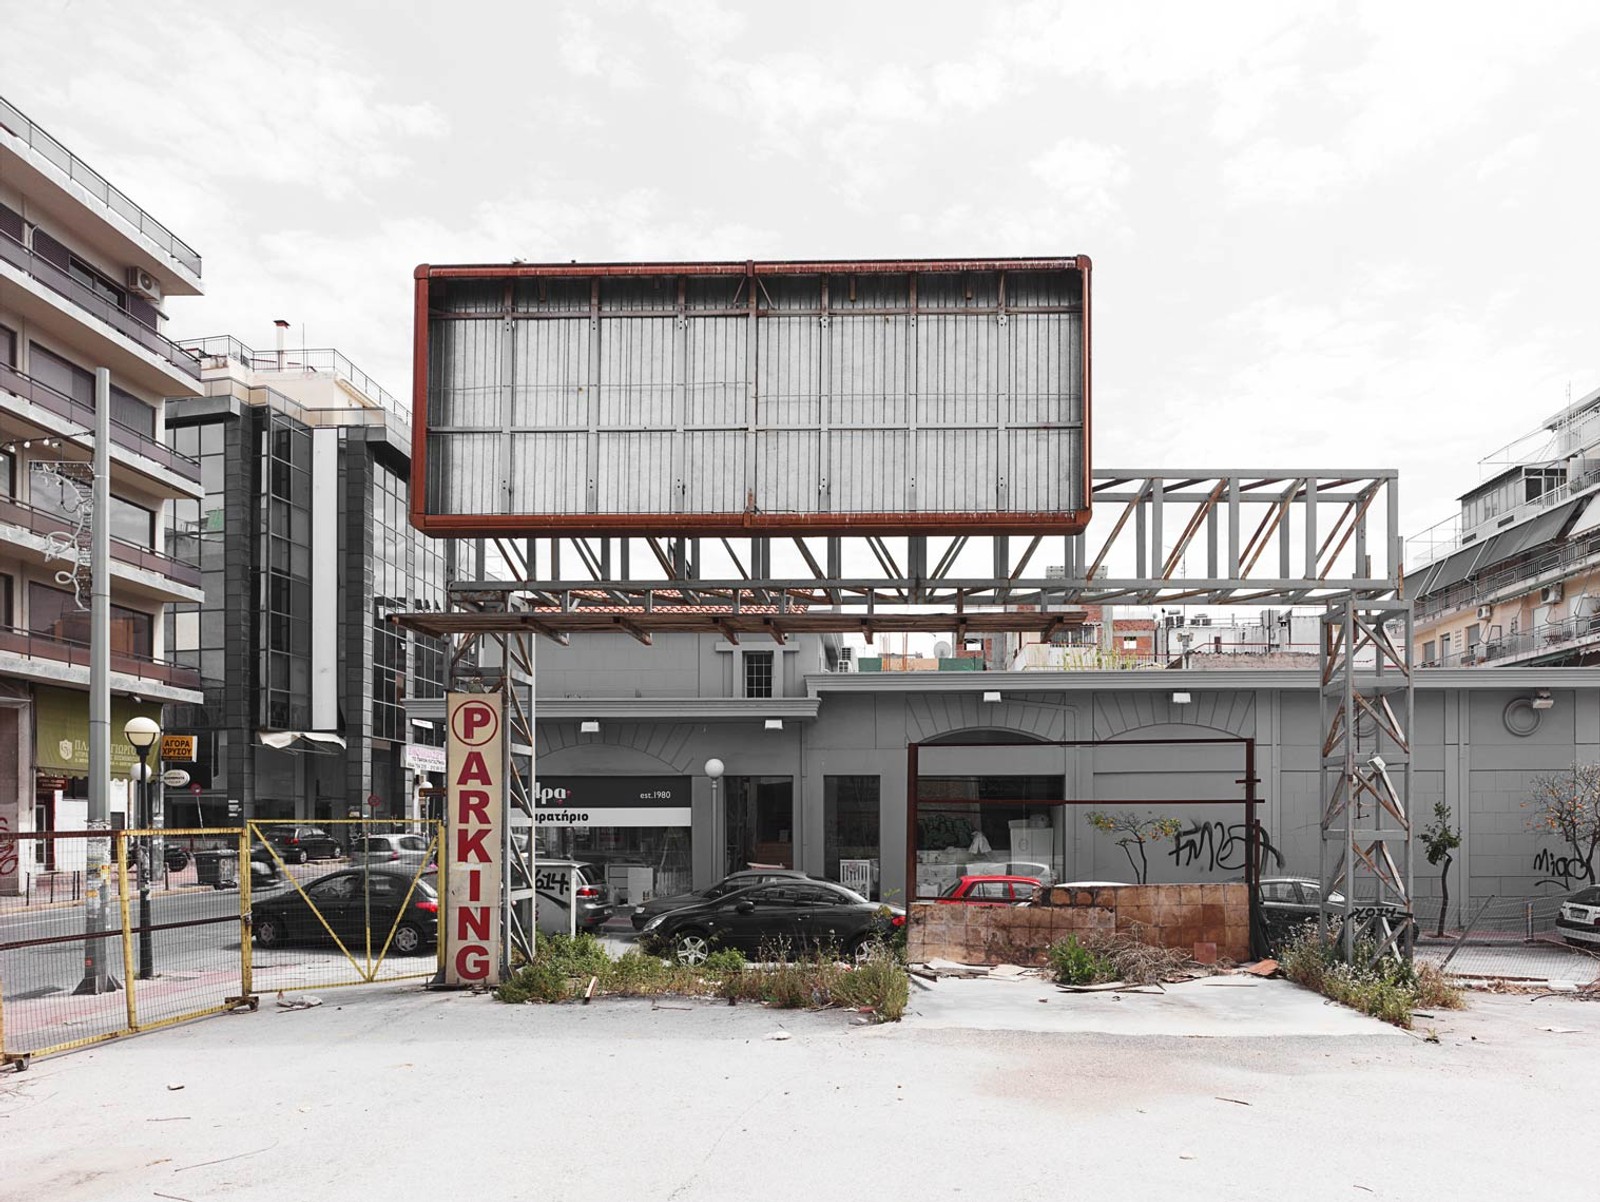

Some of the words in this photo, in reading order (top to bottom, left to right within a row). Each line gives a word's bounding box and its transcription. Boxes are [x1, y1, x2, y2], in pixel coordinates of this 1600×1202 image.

[164, 740, 190, 748] ΑΓΟΡΑ
[163, 747, 192, 755] ΧΡΥΣΟΥ
[639, 790, 671, 799] est.1980
[455, 706, 493, 980] PARKING
